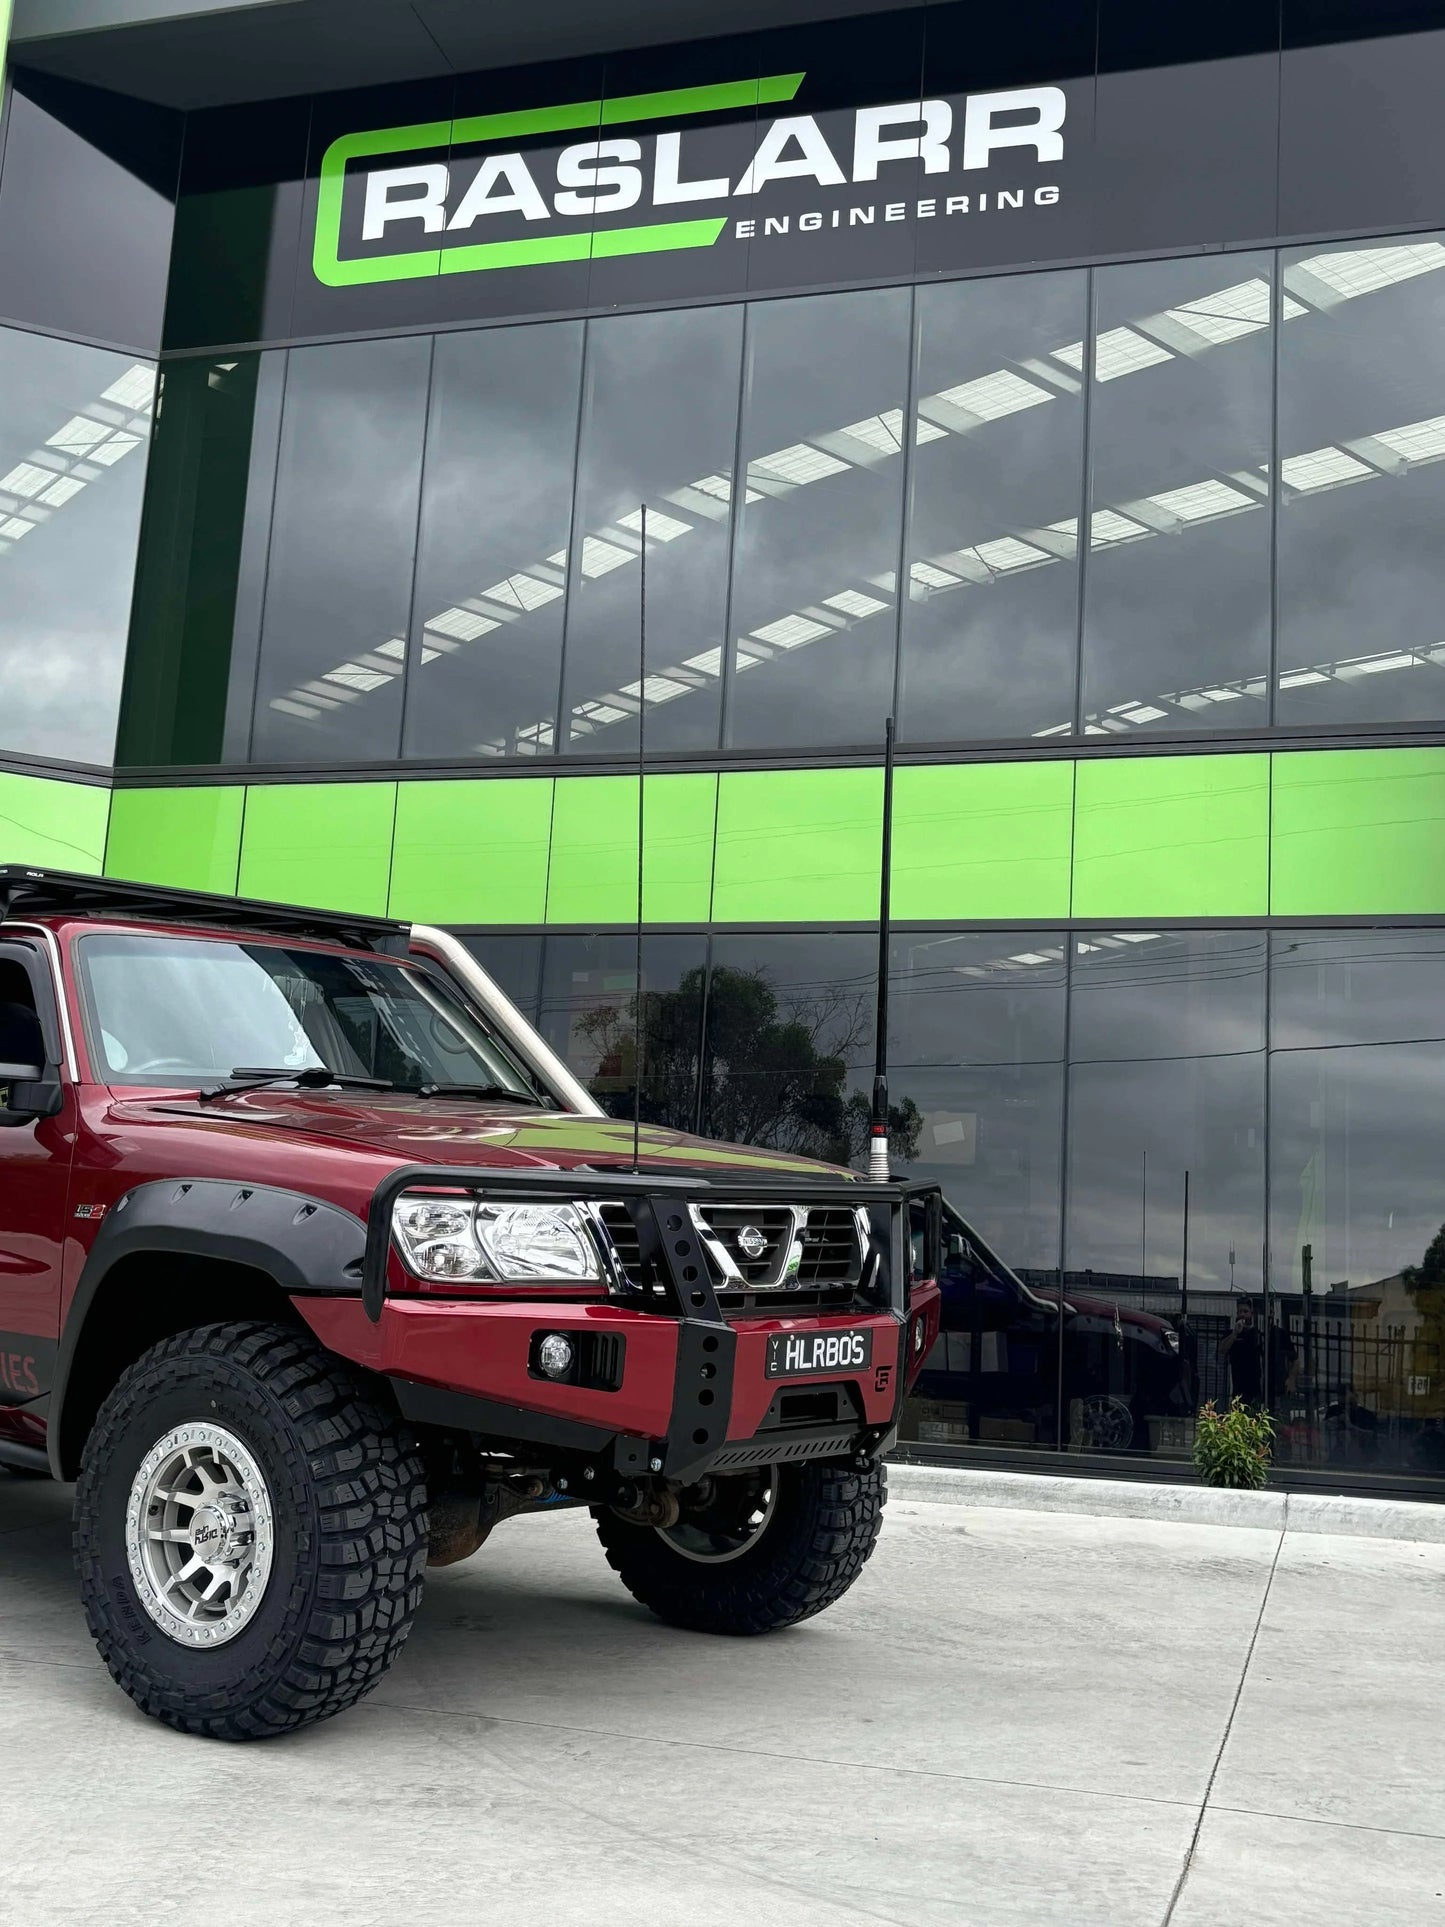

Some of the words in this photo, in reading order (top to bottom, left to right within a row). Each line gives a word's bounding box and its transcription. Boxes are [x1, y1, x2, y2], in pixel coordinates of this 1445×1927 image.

[362, 86, 1067, 241] RASLARR
[735, 186, 1060, 238] ENGINEERING
[770, 1340, 779, 1371] VIC
[112, 1575, 152, 1645] KENDA
